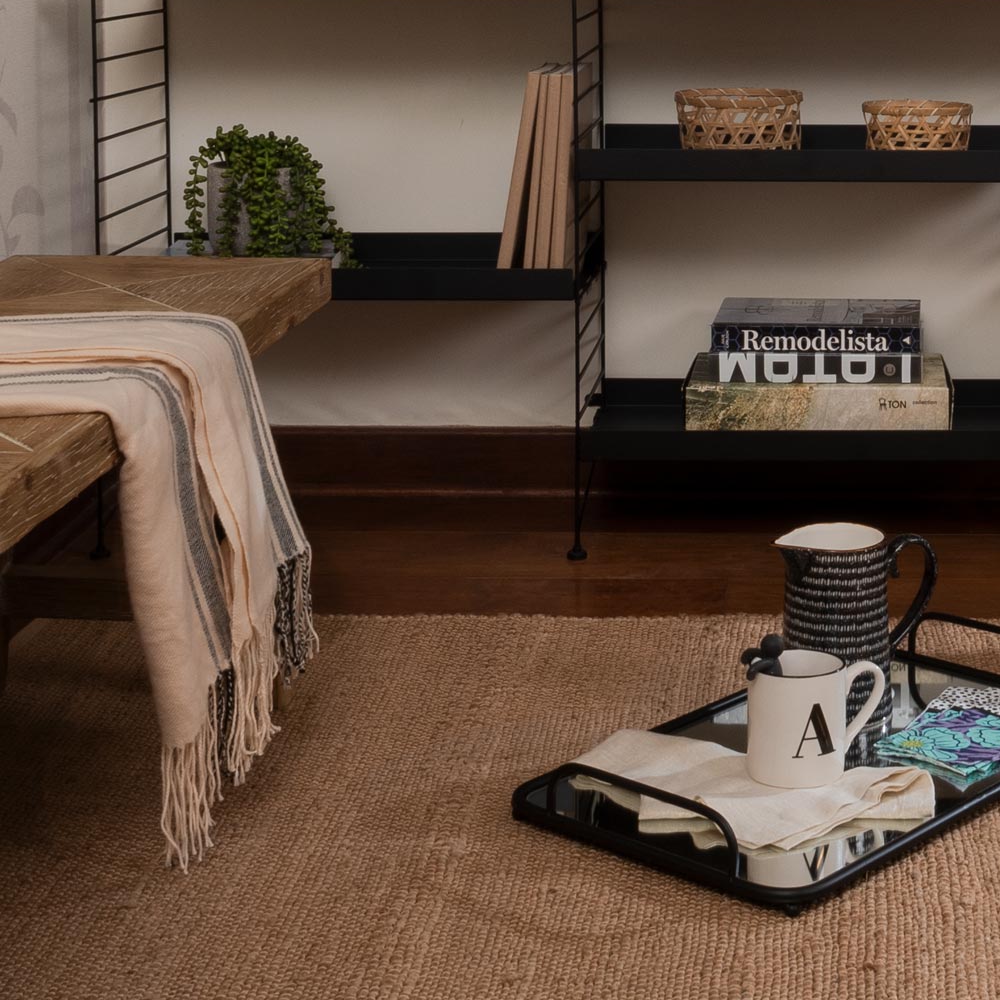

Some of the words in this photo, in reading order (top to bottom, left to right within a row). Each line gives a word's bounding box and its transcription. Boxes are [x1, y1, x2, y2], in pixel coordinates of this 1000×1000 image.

[741, 328, 890, 352] Remodelista
[887, 400, 907, 409] TON
[792, 703, 836, 759] A
